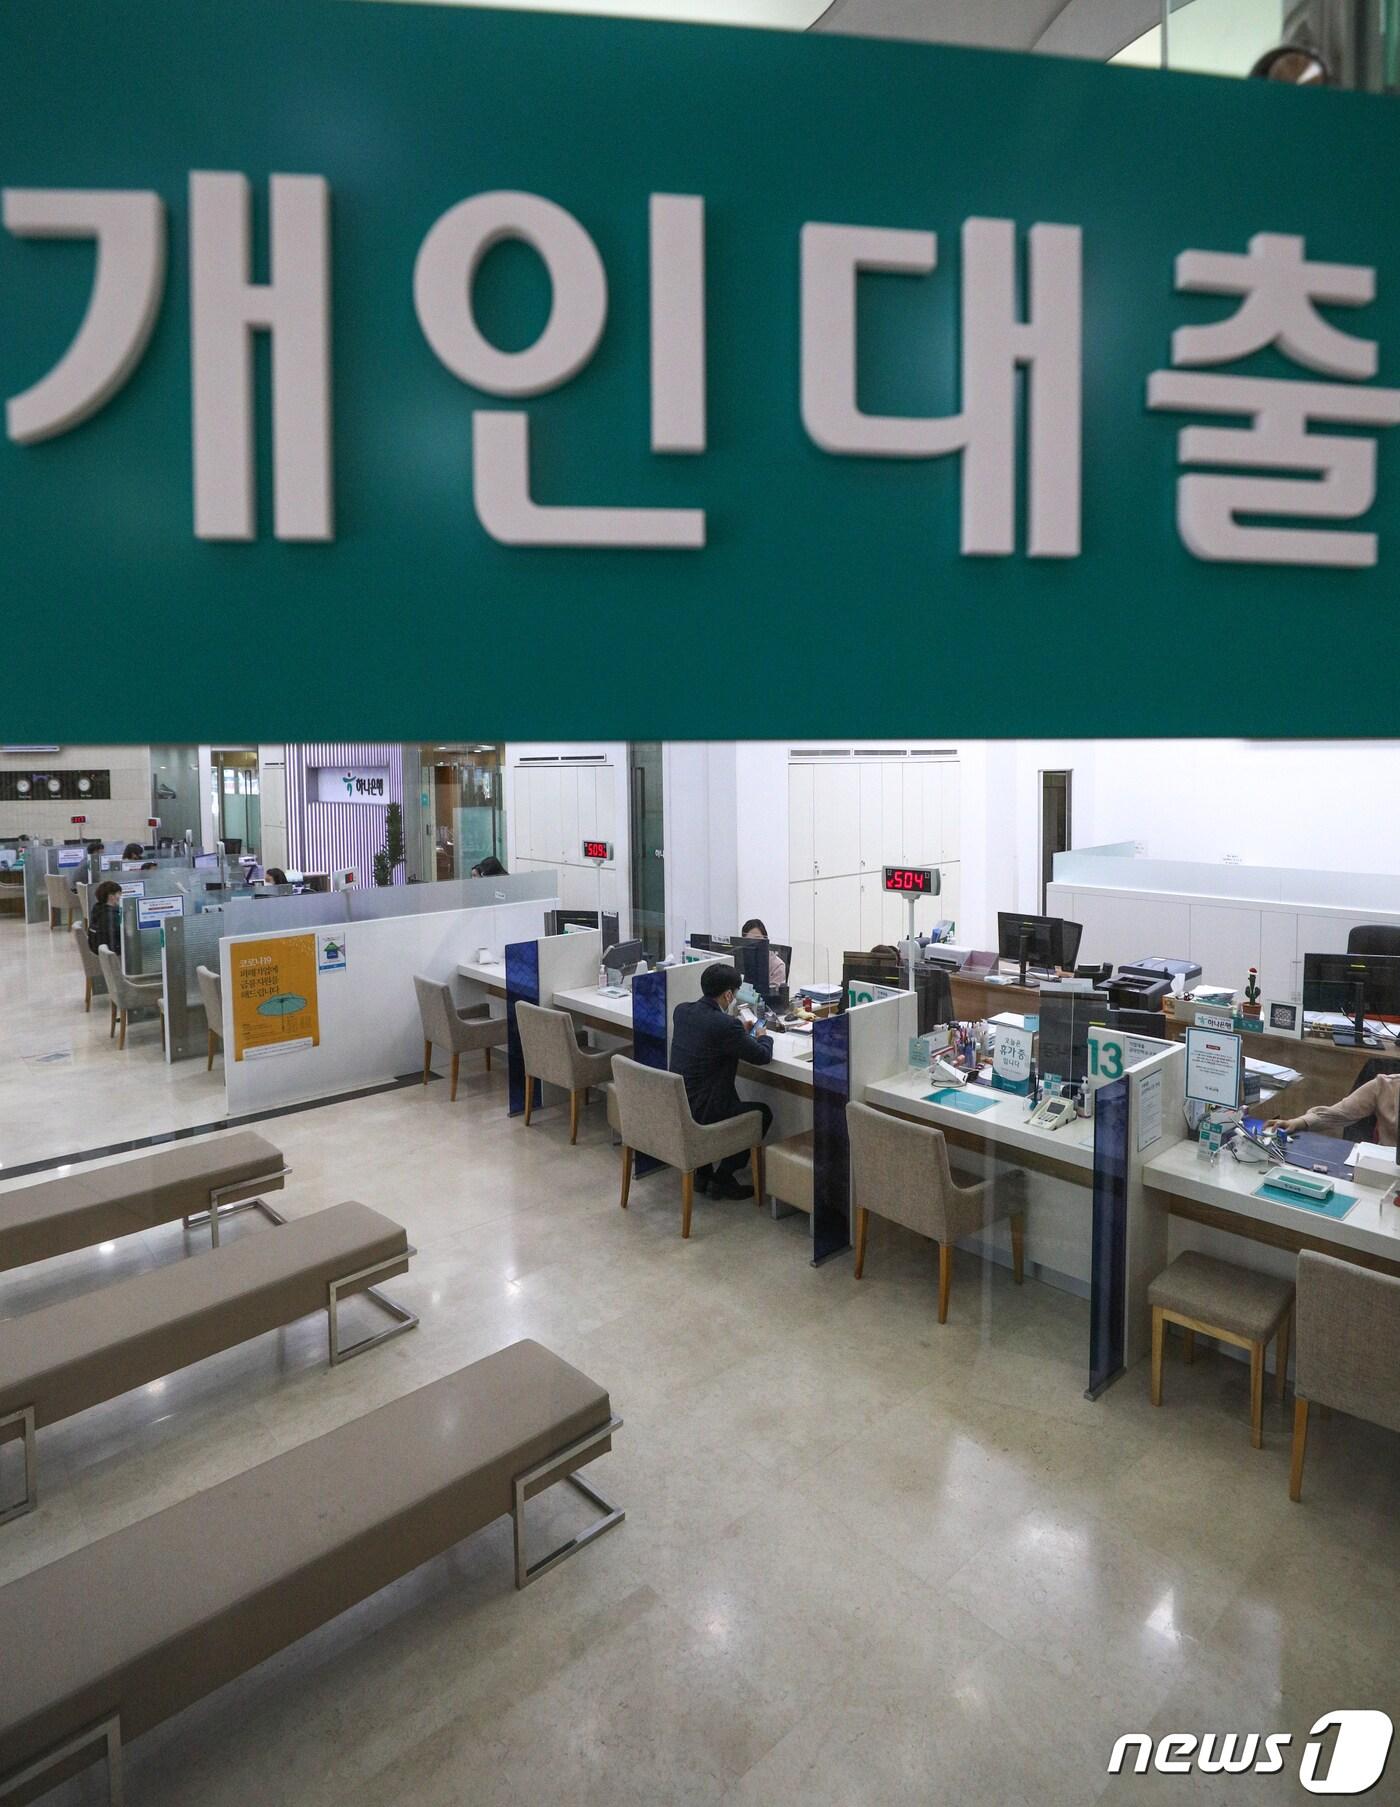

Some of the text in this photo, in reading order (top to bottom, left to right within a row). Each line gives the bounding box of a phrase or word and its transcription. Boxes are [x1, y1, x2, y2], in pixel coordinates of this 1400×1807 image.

[3, 170, 1400, 568] 개인대출
[356, 778, 384, 797] 하나은행
[588, 843, 603, 857] 509
[894, 871, 923, 889] 504
[1004, 1037, 1021, 1048] 오늘은
[1003, 1057, 1020, 1068] 입니다
[1087, 1038, 1125, 1080] 13
